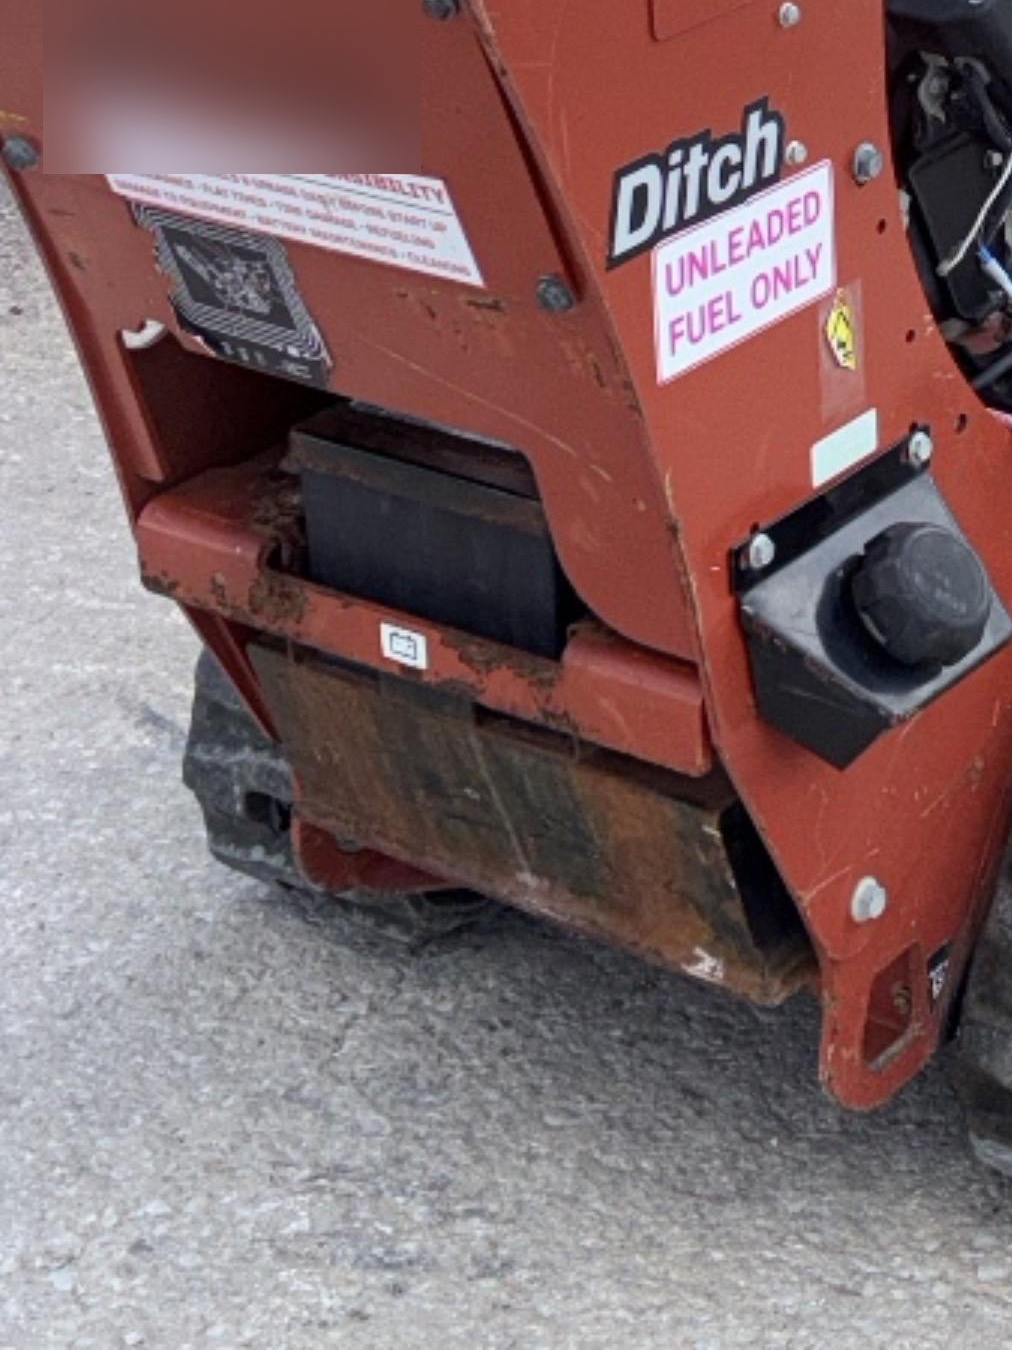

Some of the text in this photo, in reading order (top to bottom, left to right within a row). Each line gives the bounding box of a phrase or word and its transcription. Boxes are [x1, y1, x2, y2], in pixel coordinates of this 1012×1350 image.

[611, 105, 783, 259] Ditch
[664, 190, 821, 298] UNLEADED
[668, 242, 822, 357] FUEL ONLY
